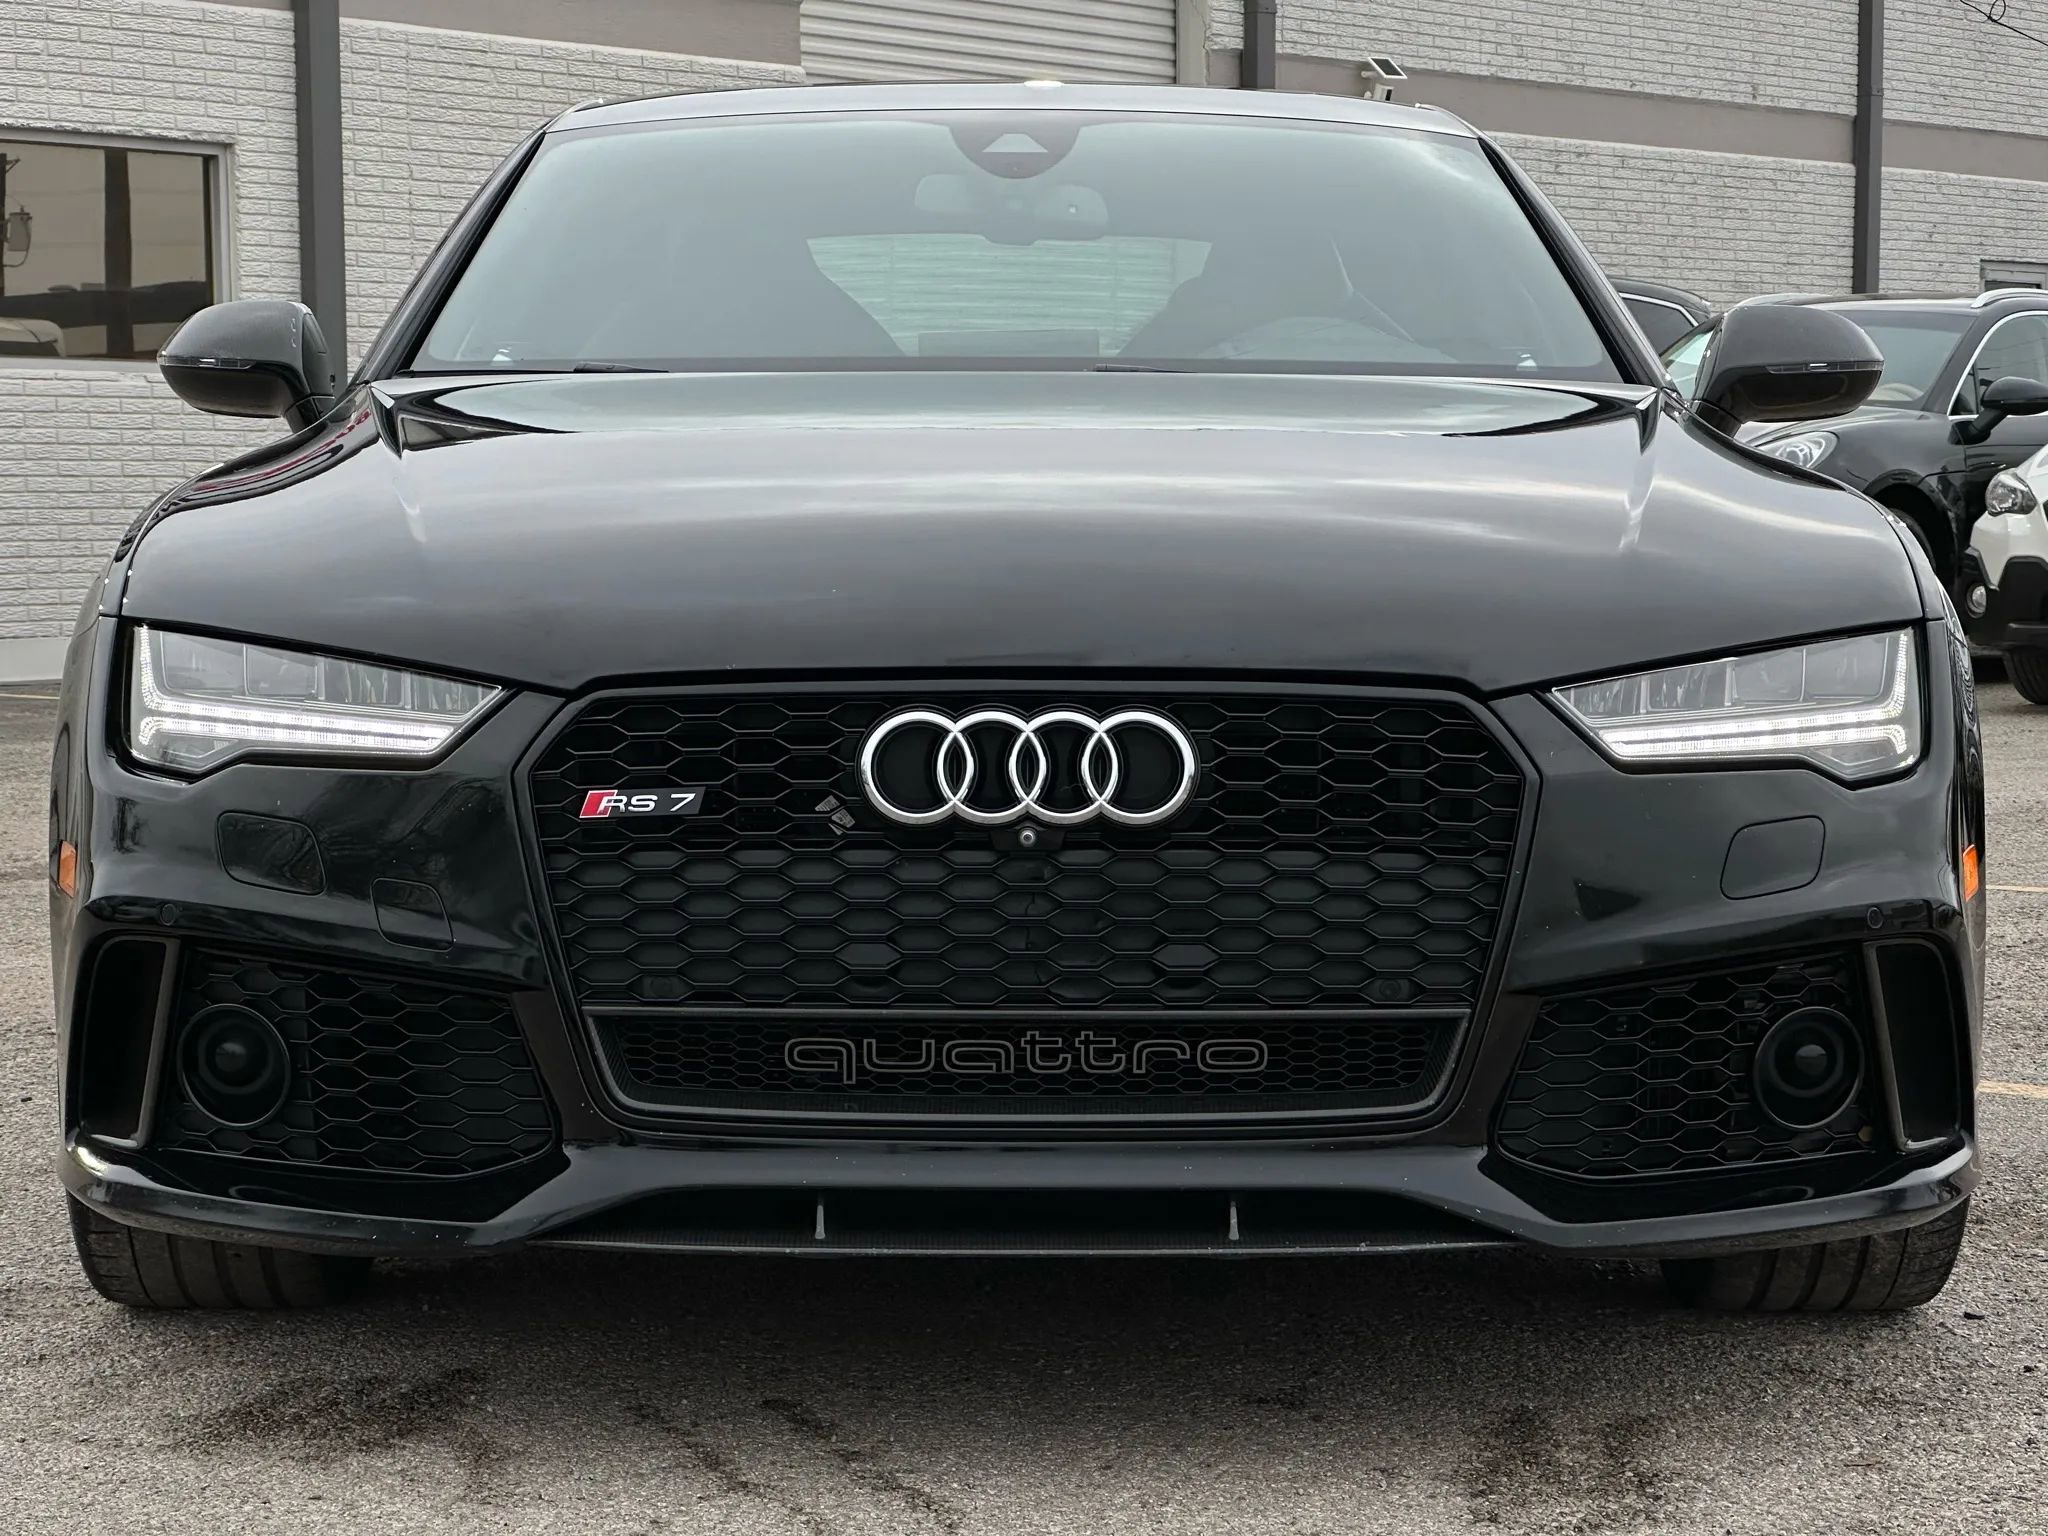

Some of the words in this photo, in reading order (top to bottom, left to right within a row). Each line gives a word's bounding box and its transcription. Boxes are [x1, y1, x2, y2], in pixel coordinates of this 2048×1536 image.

[597, 794, 658, 814] RS
[670, 793, 697, 812] 7
[785, 1031, 1268, 1085] quattro
